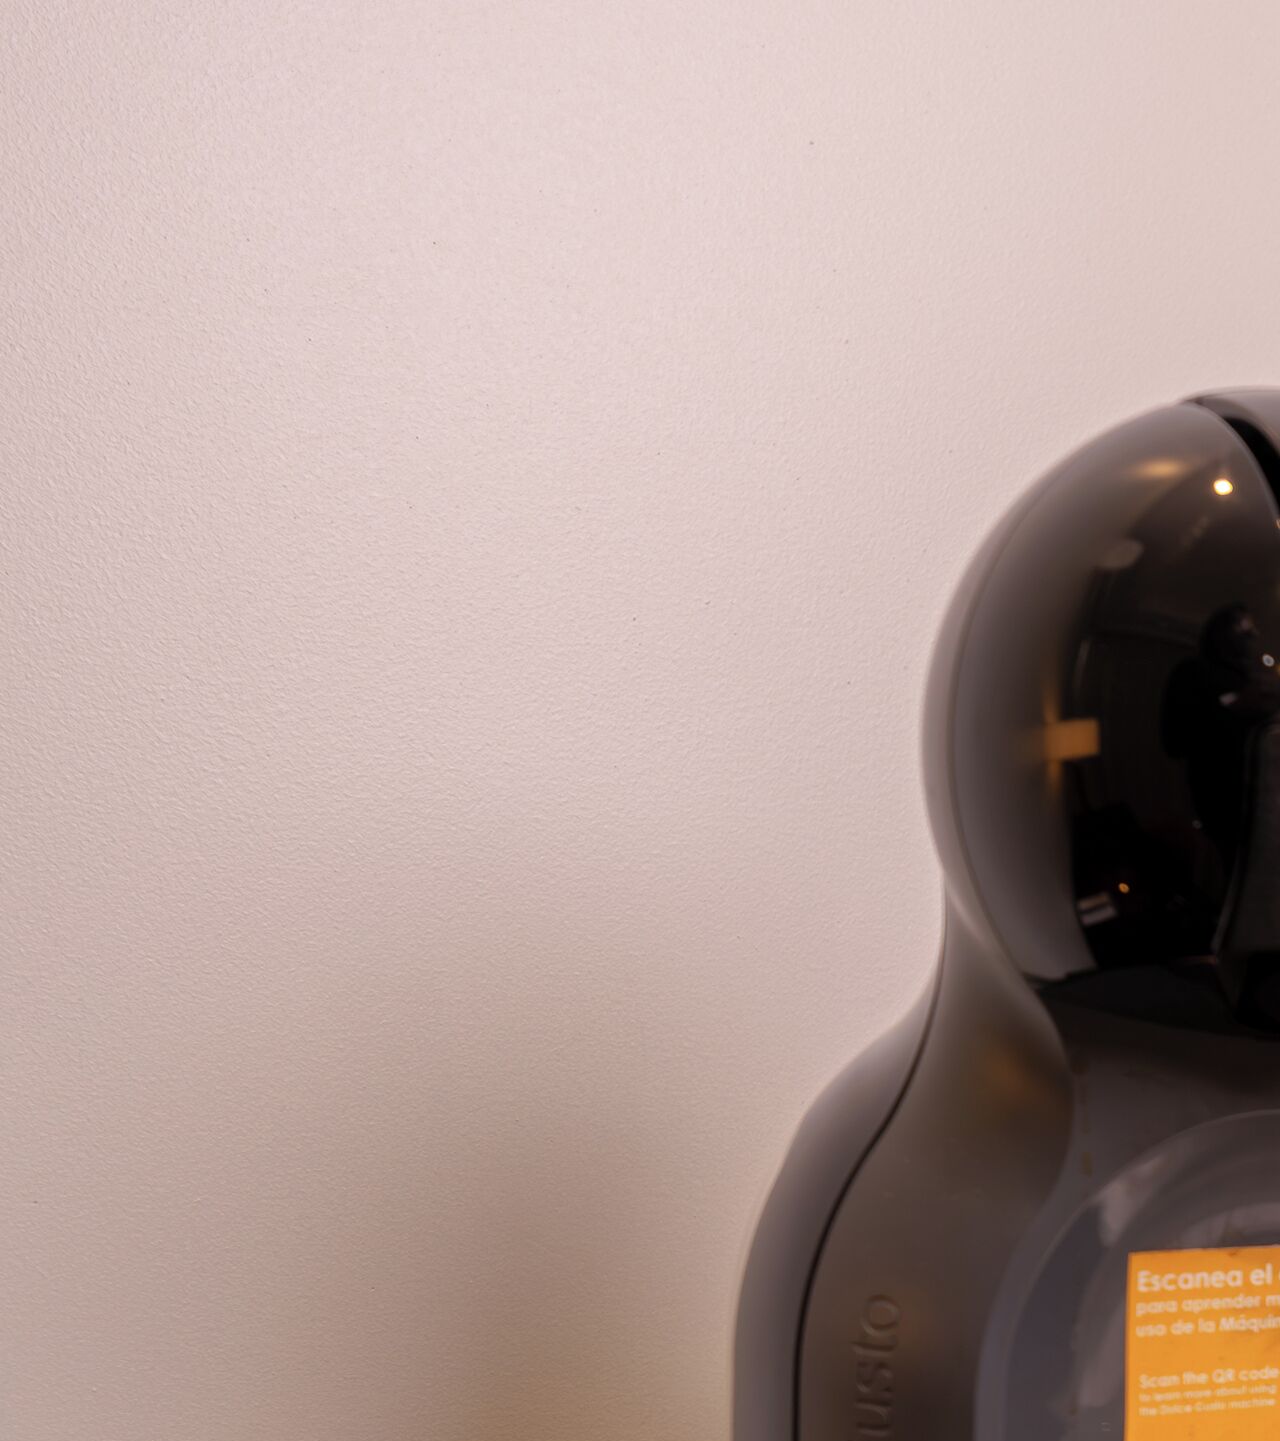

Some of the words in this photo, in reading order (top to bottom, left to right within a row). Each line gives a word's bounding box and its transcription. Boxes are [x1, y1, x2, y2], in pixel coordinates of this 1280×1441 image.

[1136, 1269, 1244, 1292] Escanea
[1250, 1262, 1273, 1286] el
[1135, 1300, 1178, 1317] para
[1182, 1293, 1261, 1313] aprender
[1135, 1324, 1167, 1337] uso
[1170, 1319, 1194, 1335] de
[1198, 1318, 1216, 1333] la
[1138, 1373, 1180, 1389] Scan
[1183, 1371, 1209, 1385] the
[1212, 1368, 1236, 1384] QR
[1239, 1365, 1280, 1380] code
